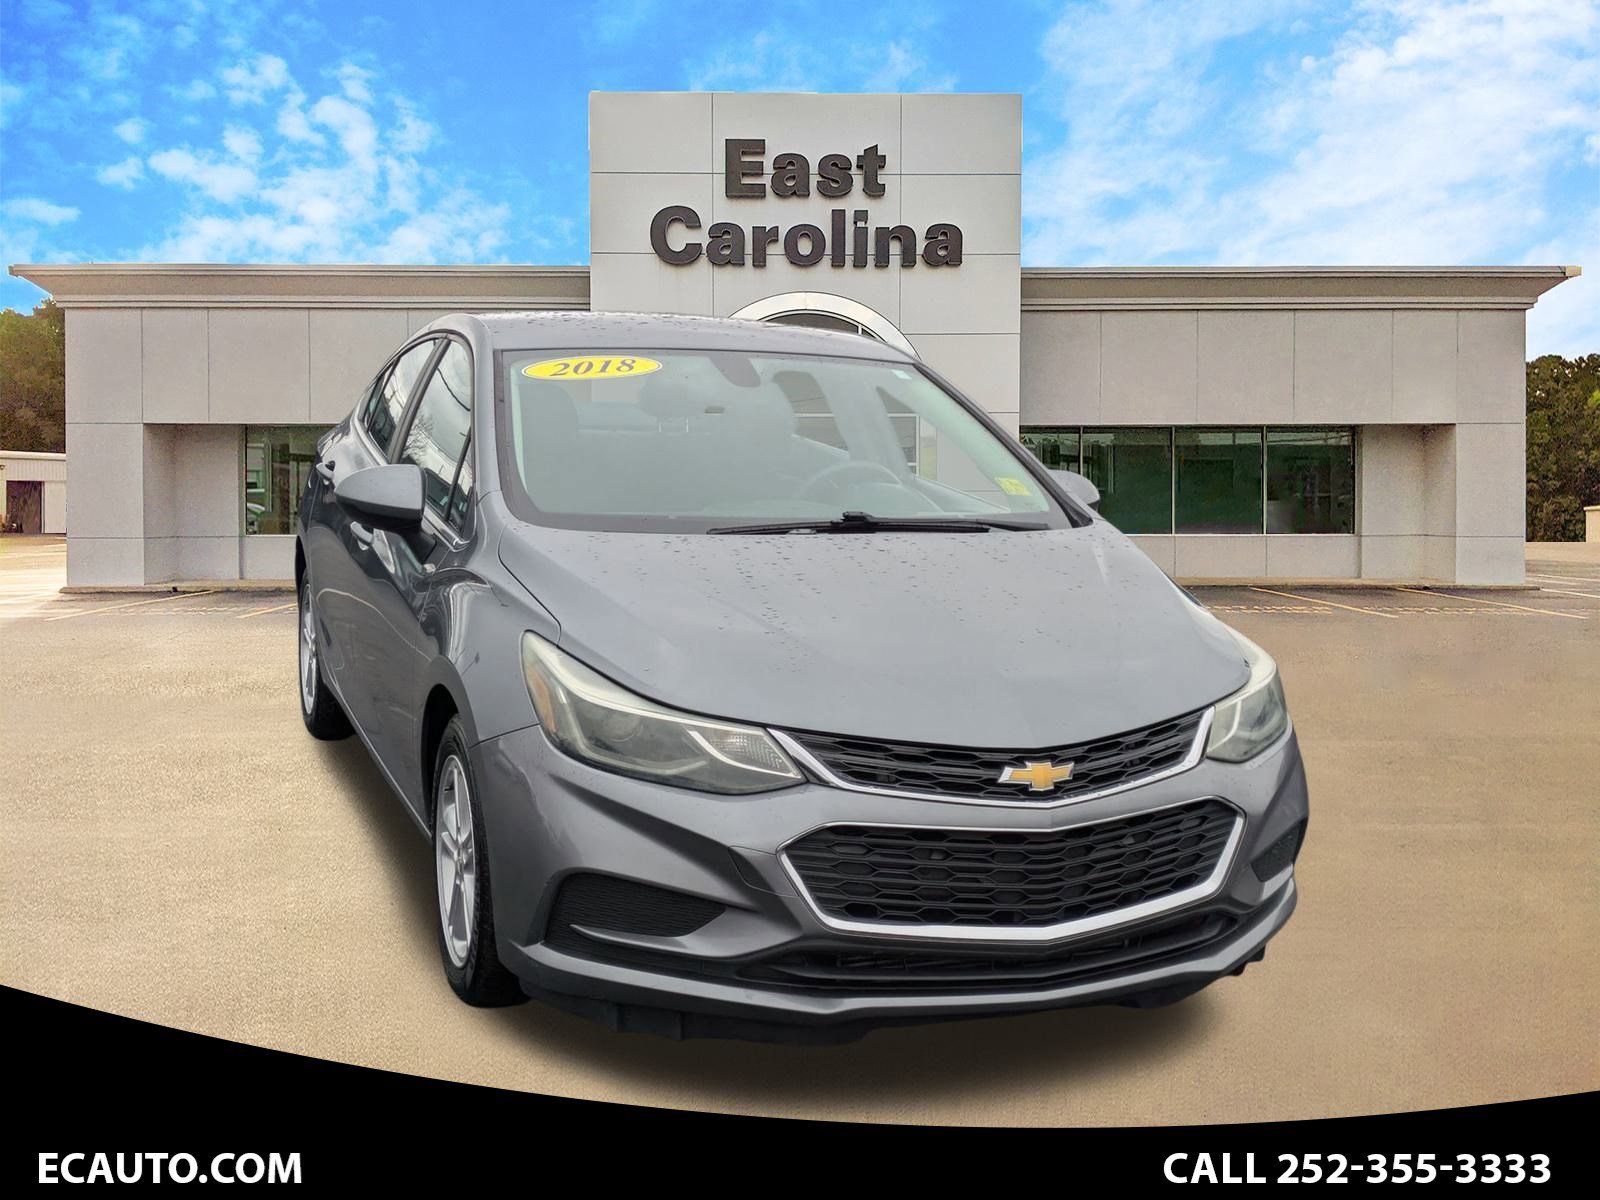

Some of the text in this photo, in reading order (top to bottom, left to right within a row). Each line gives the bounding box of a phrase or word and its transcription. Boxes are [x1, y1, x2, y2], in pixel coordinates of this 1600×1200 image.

[725, 139, 886, 200] East
[650, 206, 962, 269] Carolina
[549, 358, 637, 377] 2018
